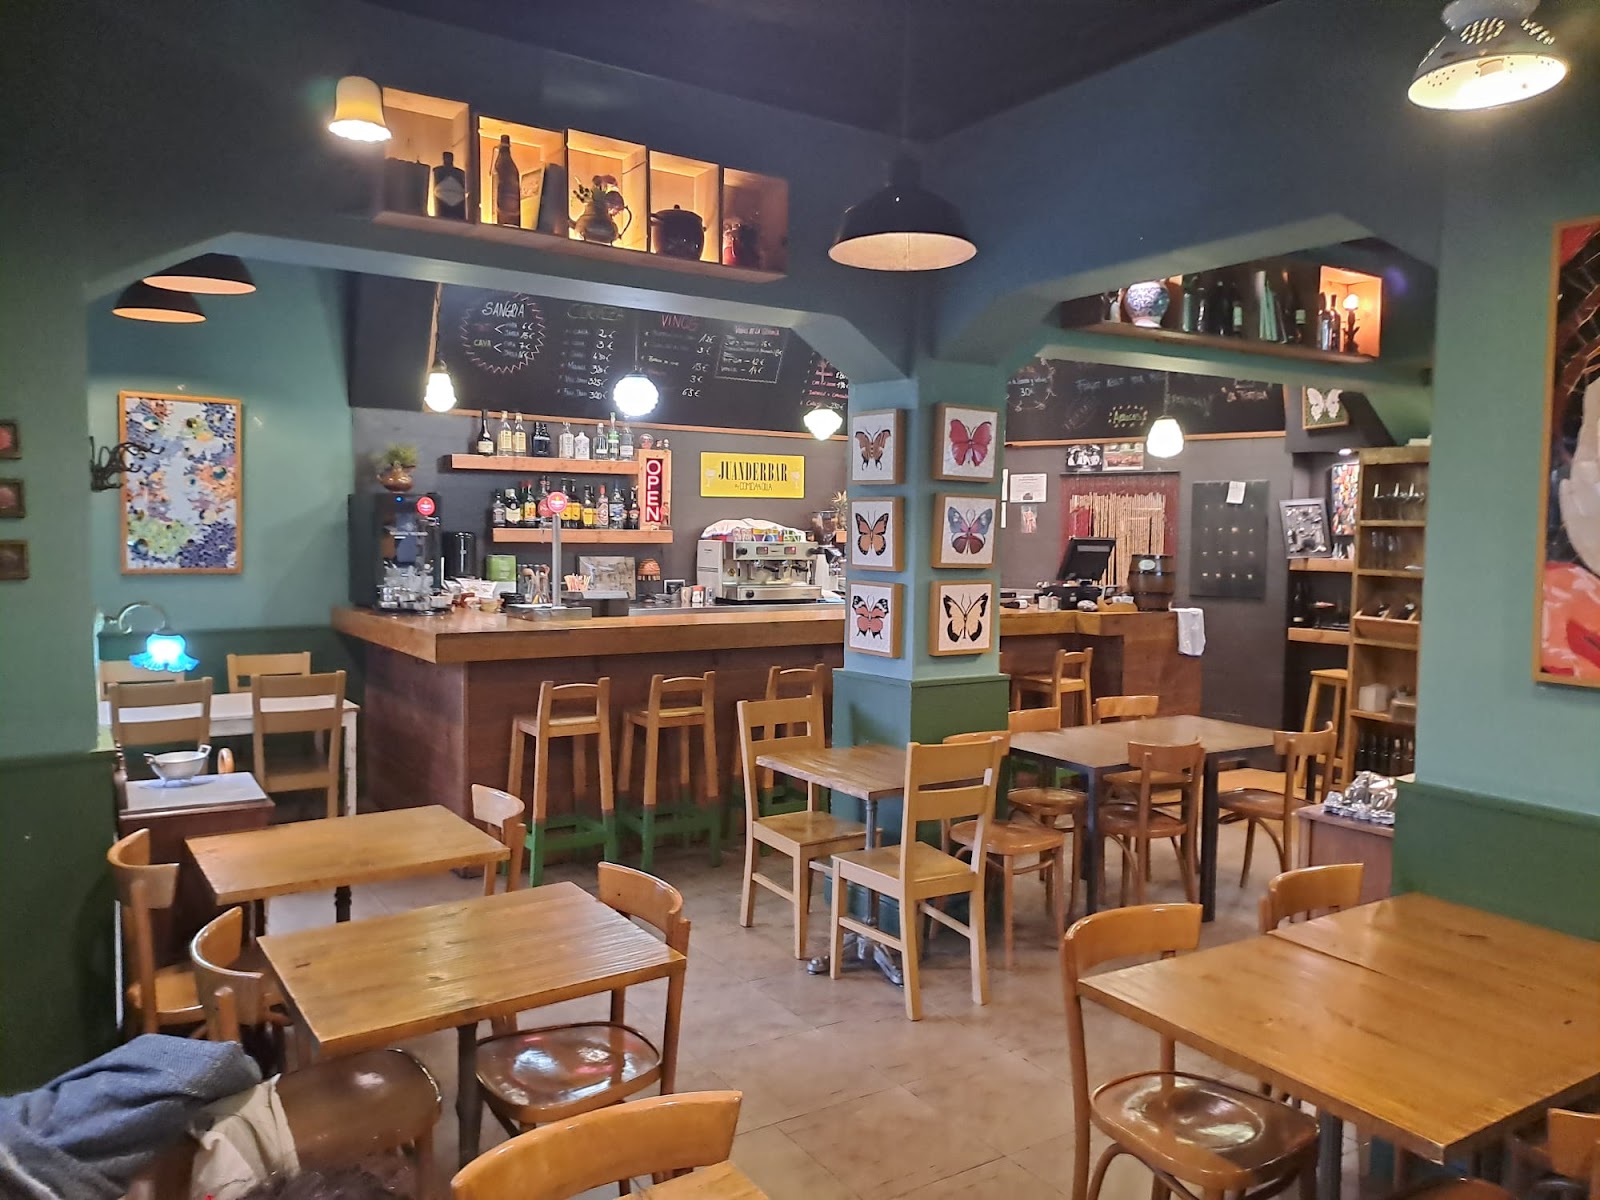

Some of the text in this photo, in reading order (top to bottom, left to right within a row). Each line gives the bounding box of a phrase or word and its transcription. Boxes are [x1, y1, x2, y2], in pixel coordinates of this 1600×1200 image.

[481, 301, 525, 318] SANGRIA
[473, 339, 493, 348] CAVA
[718, 461, 788, 482] JUANDERBAR
[646, 460, 662, 521] OPEN
